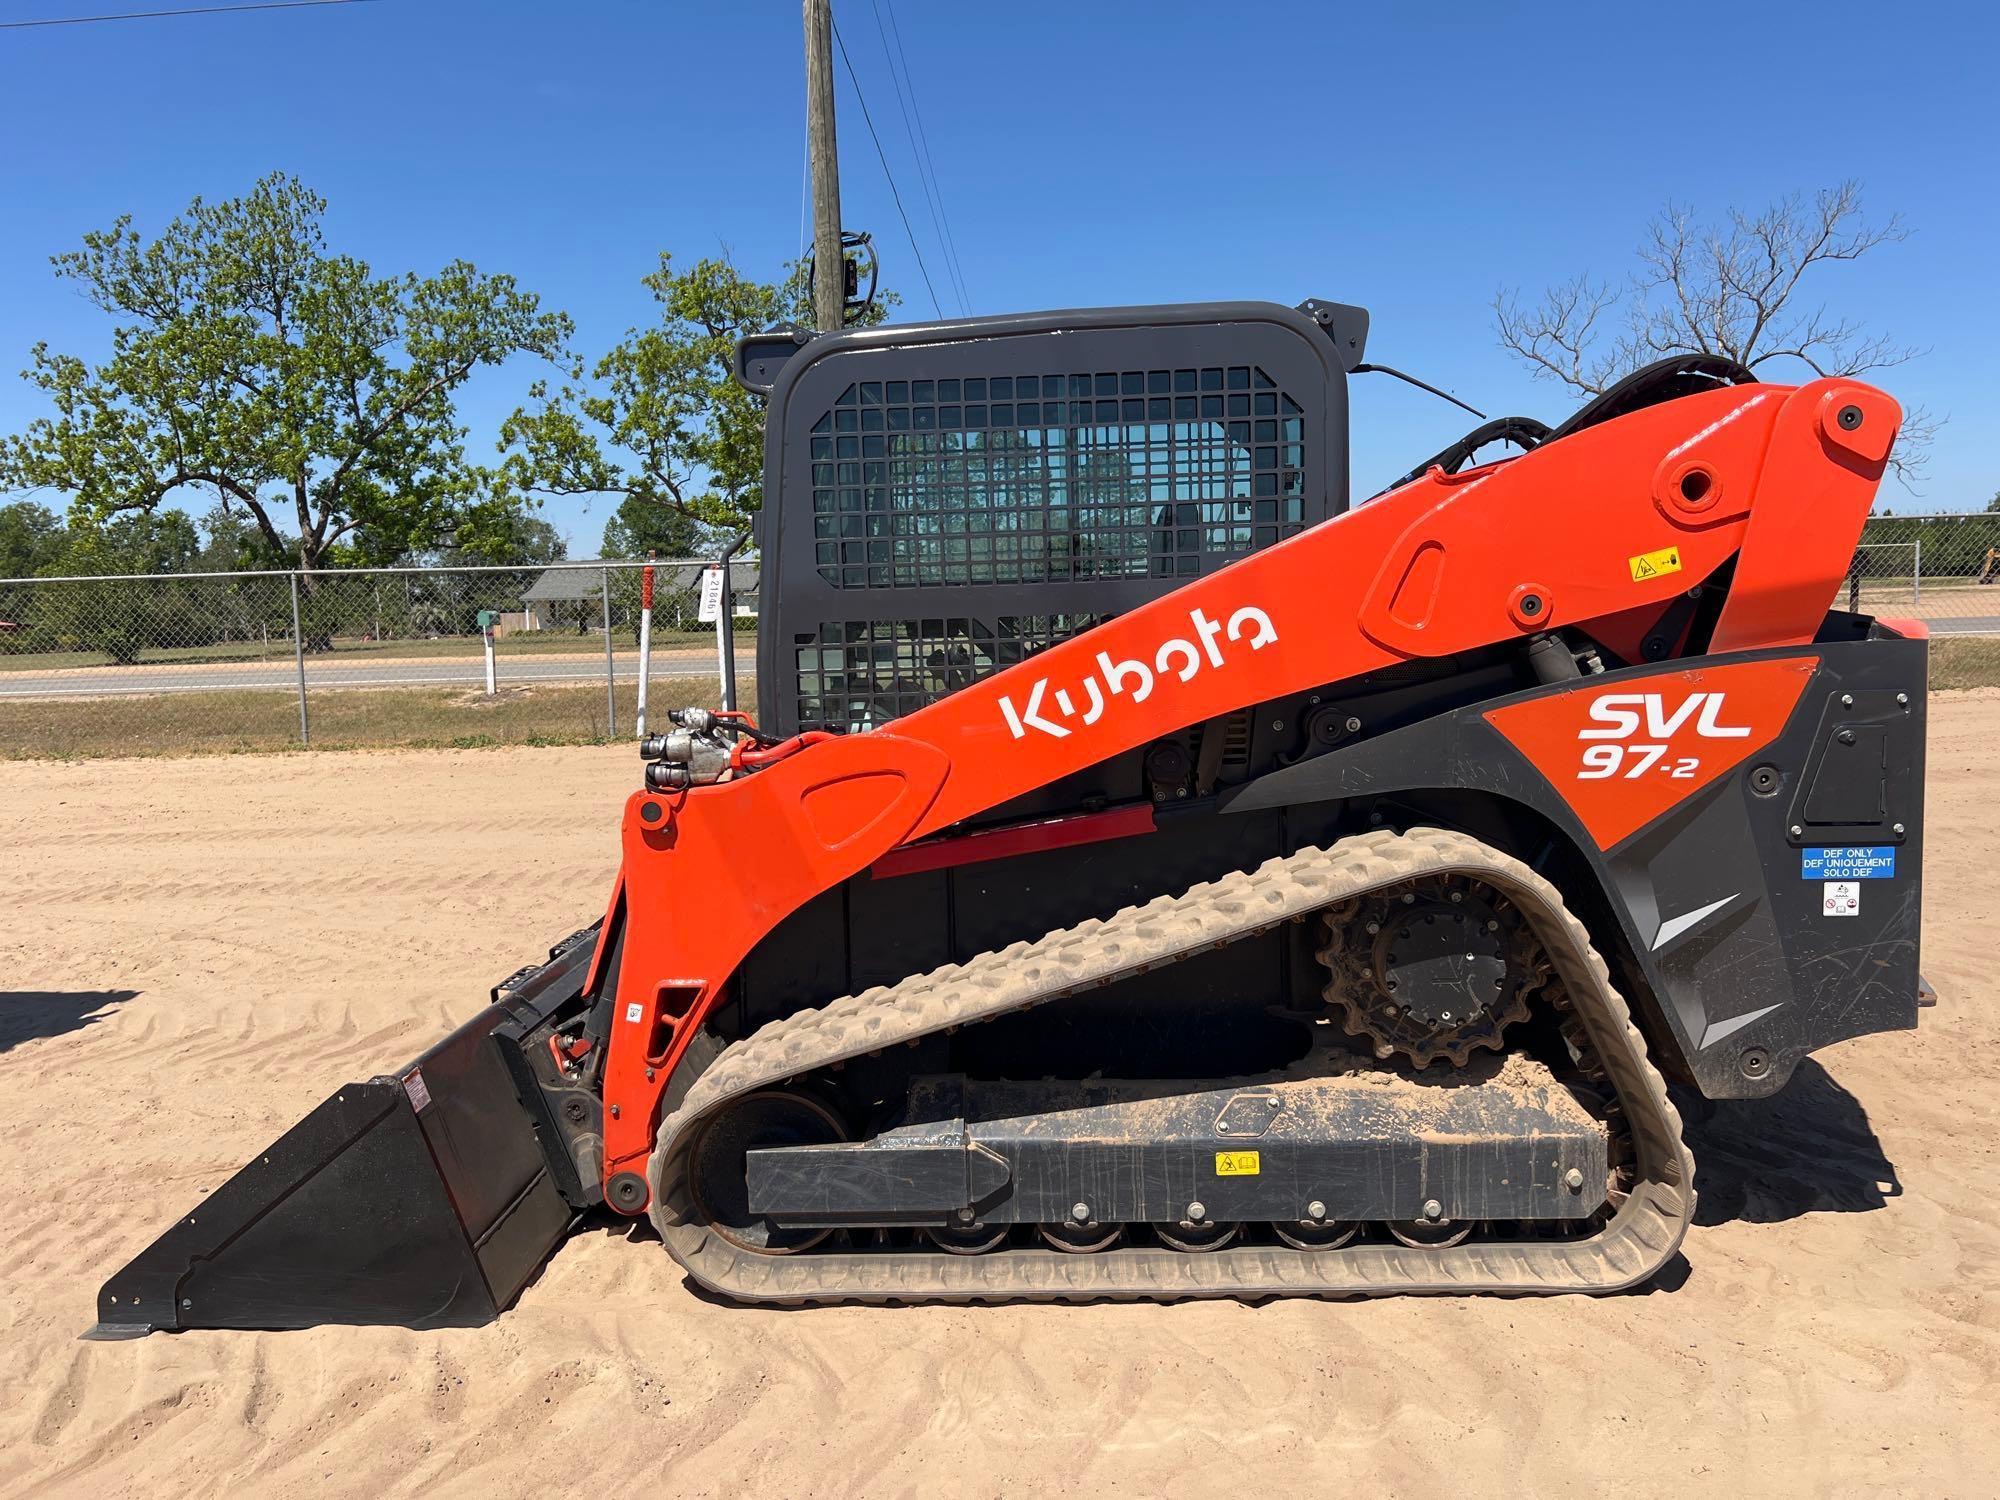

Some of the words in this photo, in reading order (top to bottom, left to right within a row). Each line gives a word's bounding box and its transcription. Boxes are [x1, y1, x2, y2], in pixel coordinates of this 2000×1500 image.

[707, 581, 719, 613] 218461
[998, 606, 1279, 739] Kubota
[1577, 692, 1752, 739] SVL
[1576, 744, 1700, 779] 97-2
[1804, 859, 1823, 868] DEF
[1826, 858, 1892, 868] UNIQUEMENT
[1823, 850, 1843, 858] DEF
[1847, 848, 1873, 858] ONLY
[1823, 868, 1849, 877] SOLO
[1852, 867, 1873, 876] DEF
